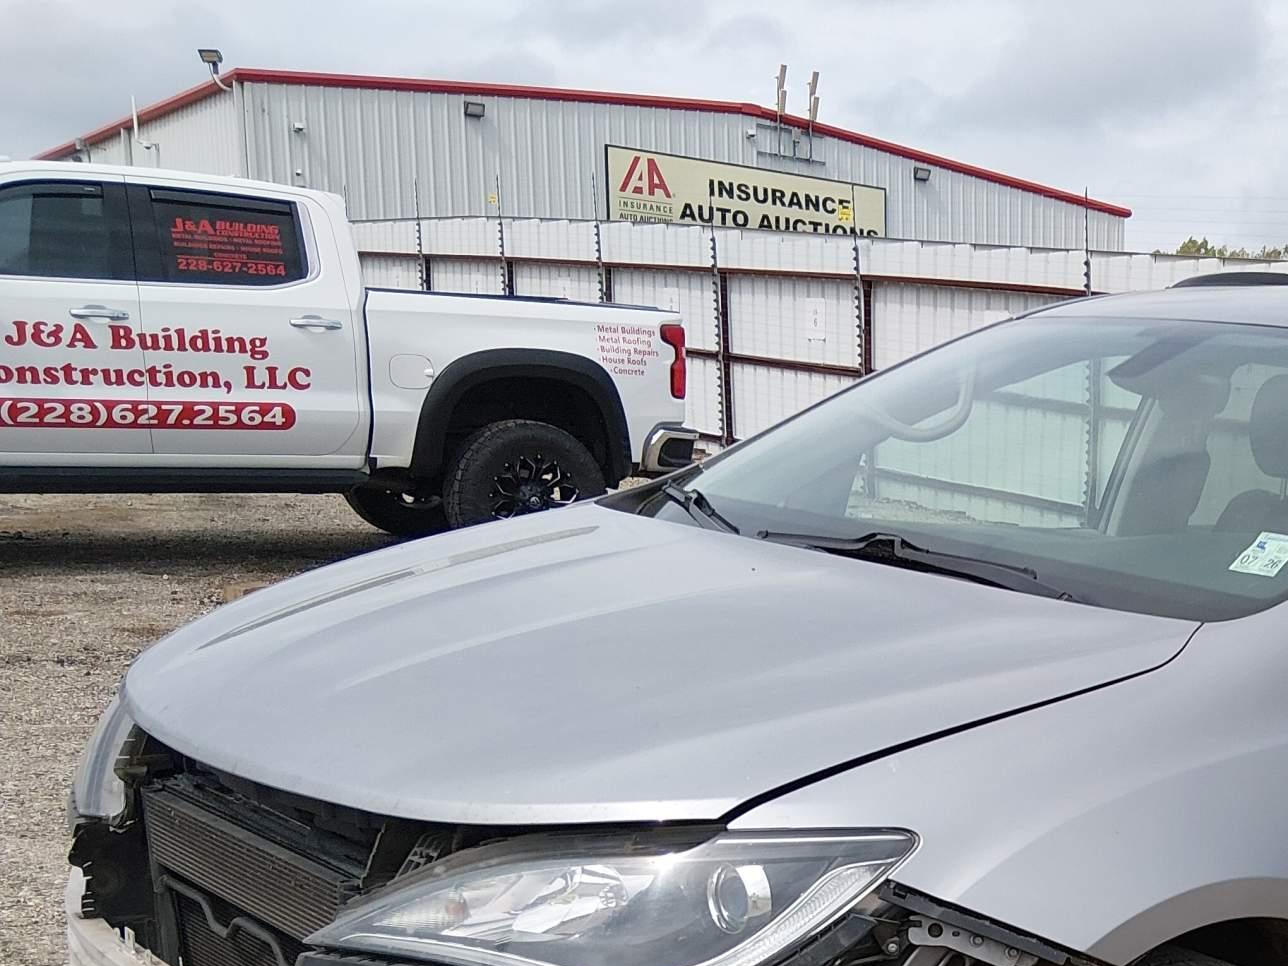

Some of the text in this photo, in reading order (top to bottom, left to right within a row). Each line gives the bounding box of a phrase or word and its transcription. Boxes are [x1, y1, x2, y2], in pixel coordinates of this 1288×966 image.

[618, 200, 673, 214] INSURANCE
[619, 212, 638, 220] AUTO
[679, 203, 750, 228] AUTO
[171, 217, 279, 235] J&A BUILDING
[177, 259, 286, 275] 228-627-2564
[597, 325, 655, 338] Metal Buildings
[5, 320, 269, 360] J&A Building
[598, 335, 651, 348] Metal Roofing
[600, 345, 659, 358] Building Repairs
[602, 355, 647, 366] House Roofs
[243, 365, 312, 390] LLC
[613, 366, 645, 376] Concrete
[1, 400, 286, 426] (228)627.2564
